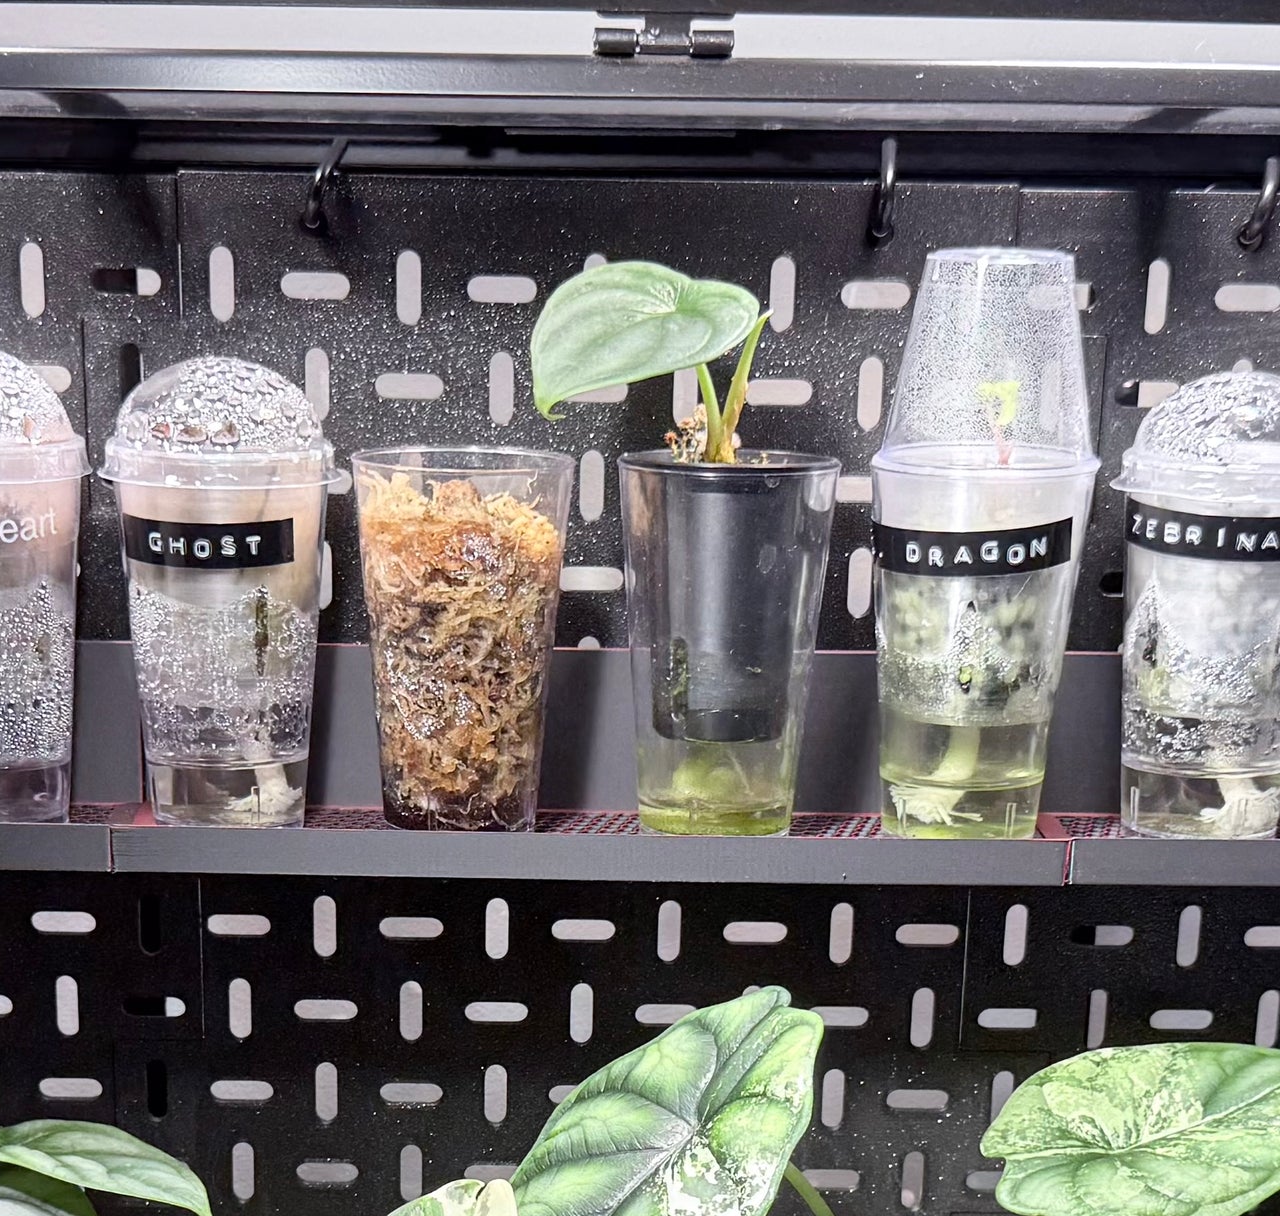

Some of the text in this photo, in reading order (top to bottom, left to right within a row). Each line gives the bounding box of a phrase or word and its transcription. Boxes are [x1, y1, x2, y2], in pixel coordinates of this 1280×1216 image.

[148, 531, 262, 560] GHOST
[1132, 513, 1280, 553] ZEBRINA
[905, 535, 1048, 568] DRAGON
